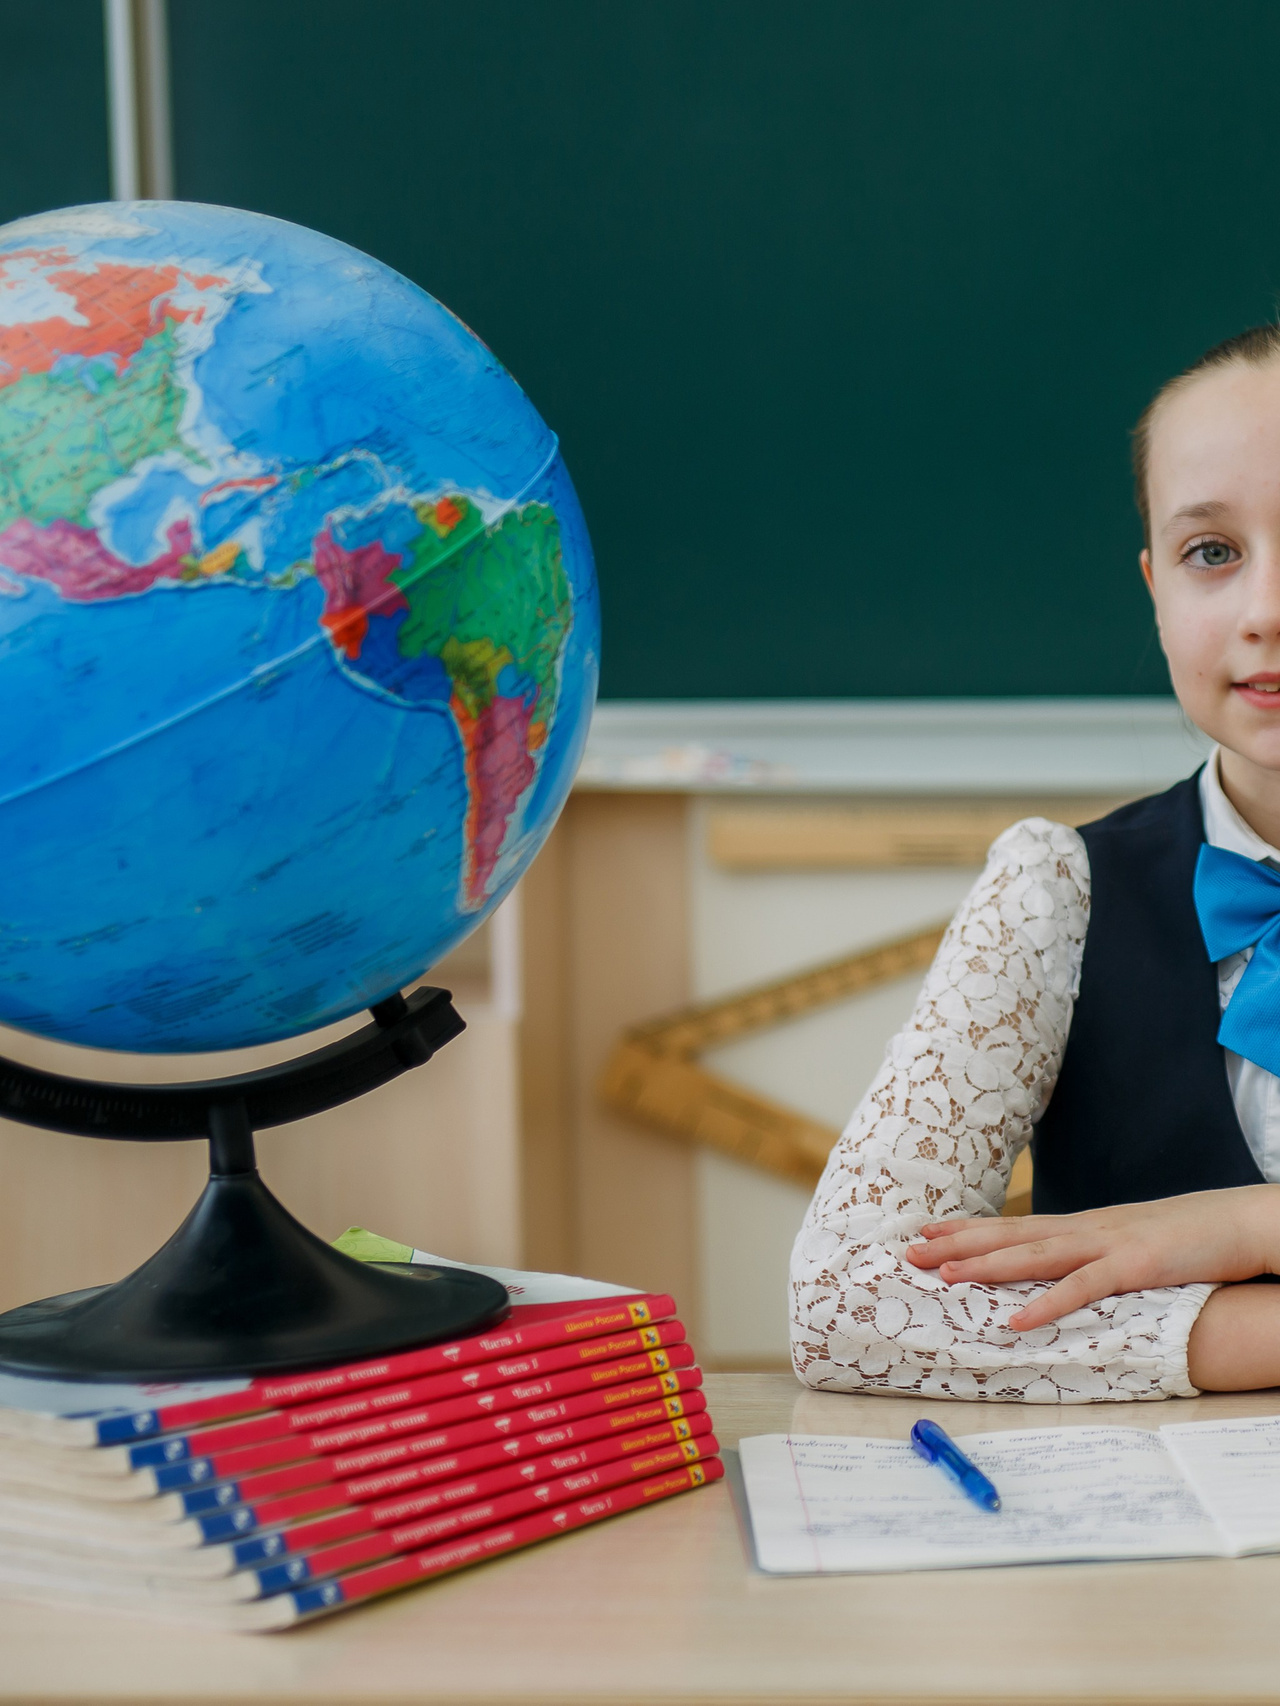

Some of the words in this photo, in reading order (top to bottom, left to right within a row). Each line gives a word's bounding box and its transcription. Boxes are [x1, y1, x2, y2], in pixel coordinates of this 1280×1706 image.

[480, 1336, 513, 1351] Часть
[497, 1362, 530, 1376] Часть
[512, 1385, 544, 1399] Часть
[527, 1408, 558, 1422] Часть
[536, 1431, 566, 1445] Часть
[551, 1455, 579, 1469] Часть
[563, 1476, 591, 1490] Часть
[580, 1501, 605, 1516] Часть
